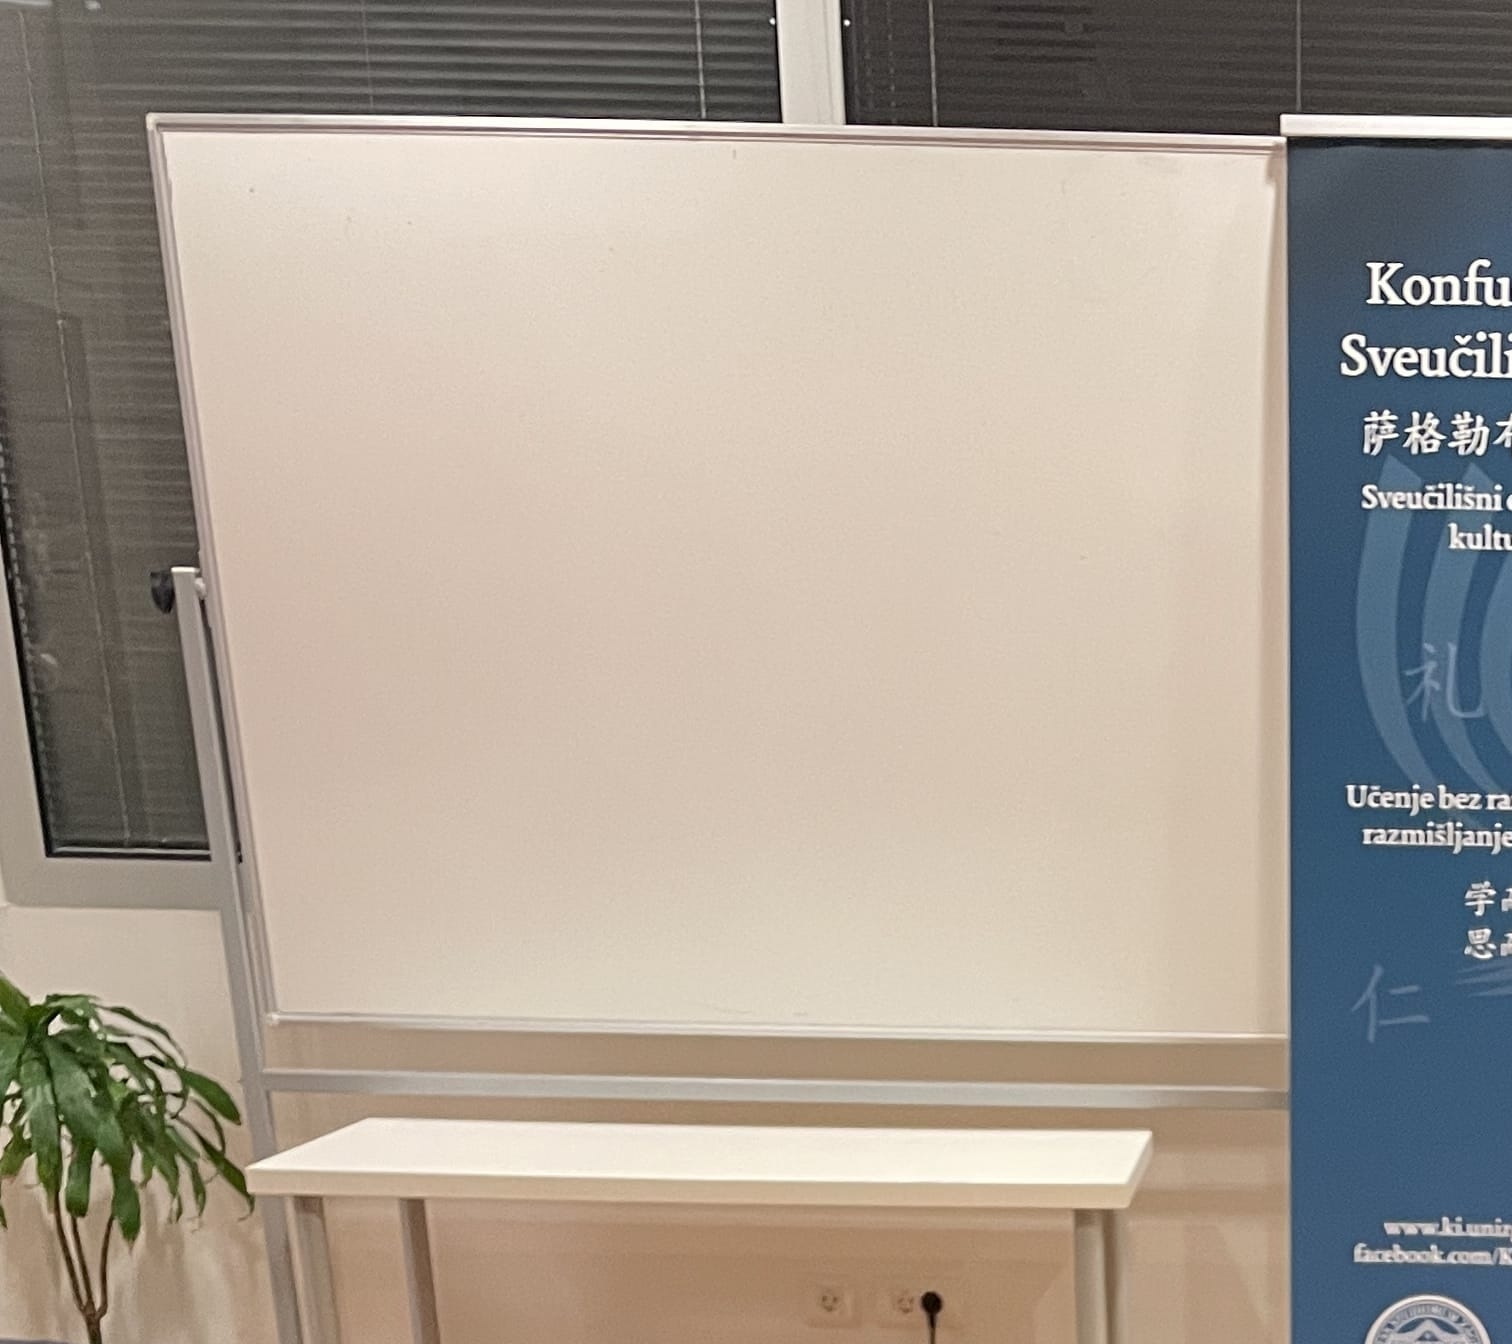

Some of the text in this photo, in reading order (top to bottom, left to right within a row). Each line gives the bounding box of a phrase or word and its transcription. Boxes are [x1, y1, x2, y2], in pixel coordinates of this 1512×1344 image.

[1361, 482, 1503, 512] Sveučilišni
[1405, 642, 1486, 721] 礼
[1346, 783, 1435, 815] Učenje
[1437, 784, 1483, 810] bez
[1351, 965, 1430, 1043] 仁
